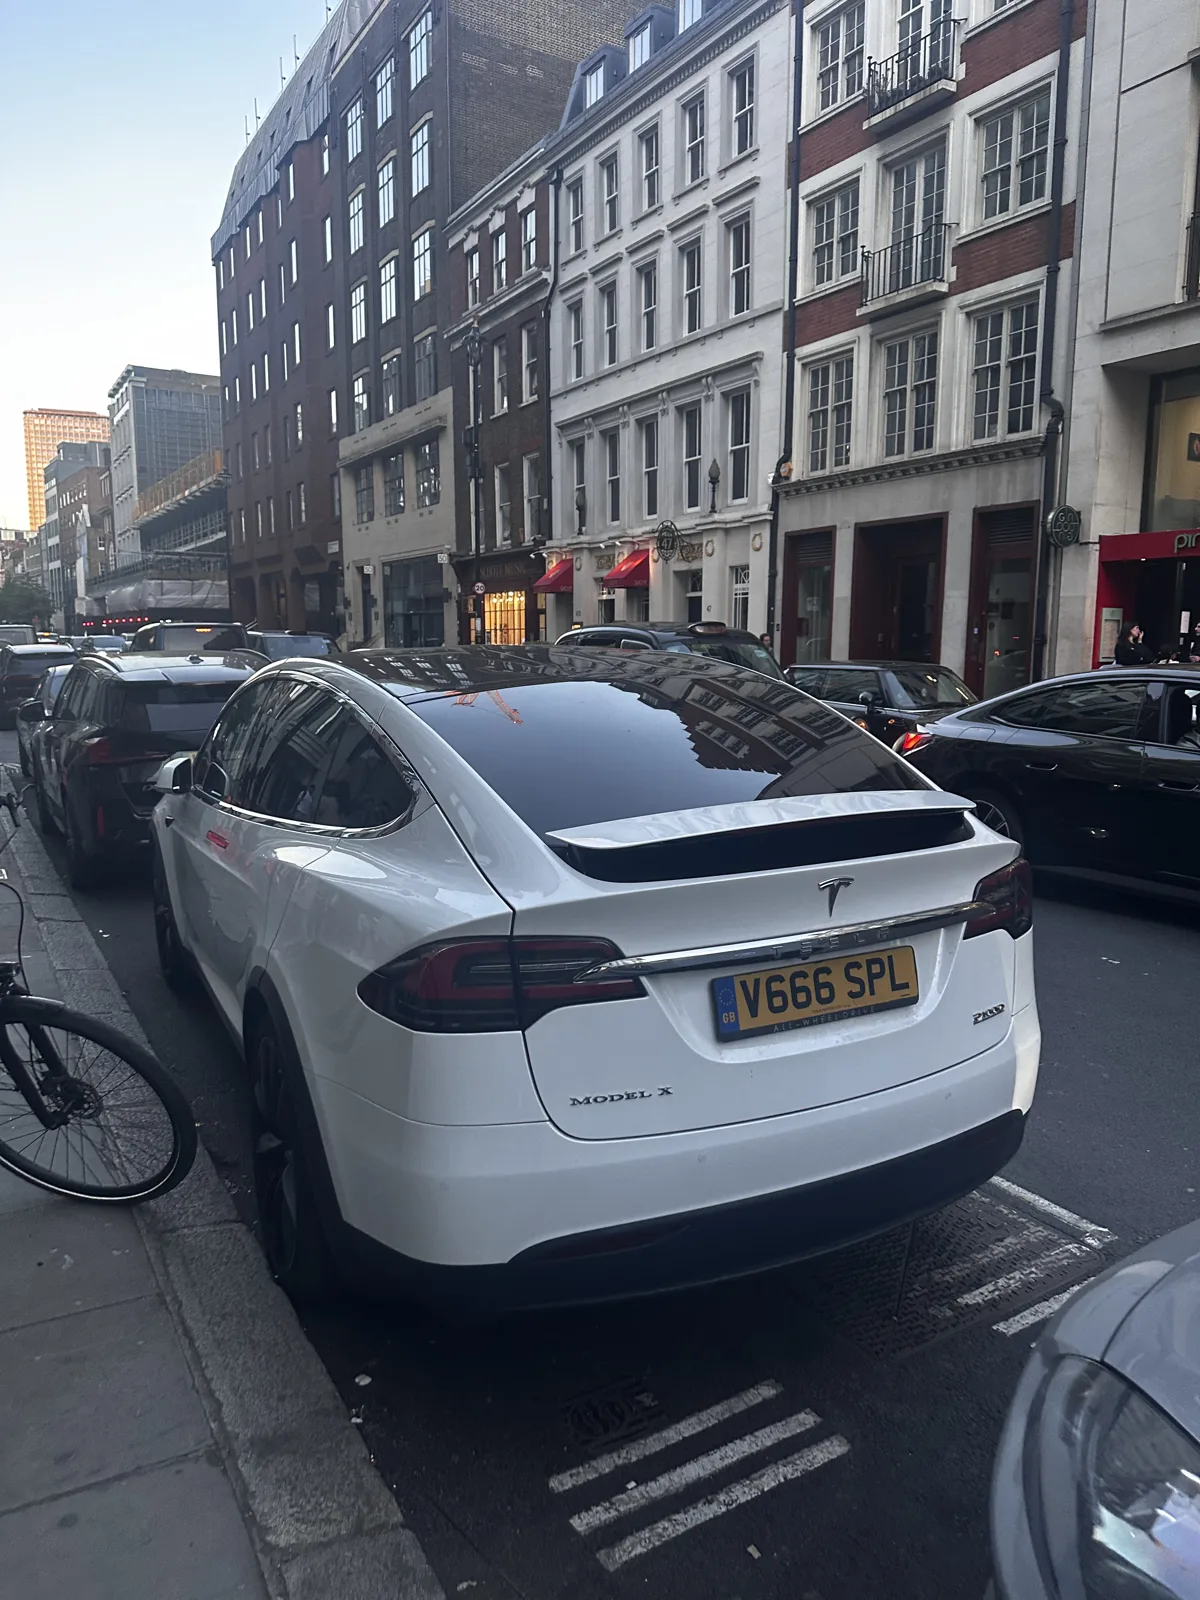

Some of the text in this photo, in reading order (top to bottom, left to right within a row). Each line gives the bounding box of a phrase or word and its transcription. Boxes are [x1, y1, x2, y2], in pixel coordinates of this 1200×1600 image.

[661, 538, 673, 550] 47
[739, 954, 910, 1019] V666 SPL
[722, 1011, 736, 1024] GB
[842, 1005, 876, 1020] DRIVE
[569, 1086, 674, 1106] MODEL X
